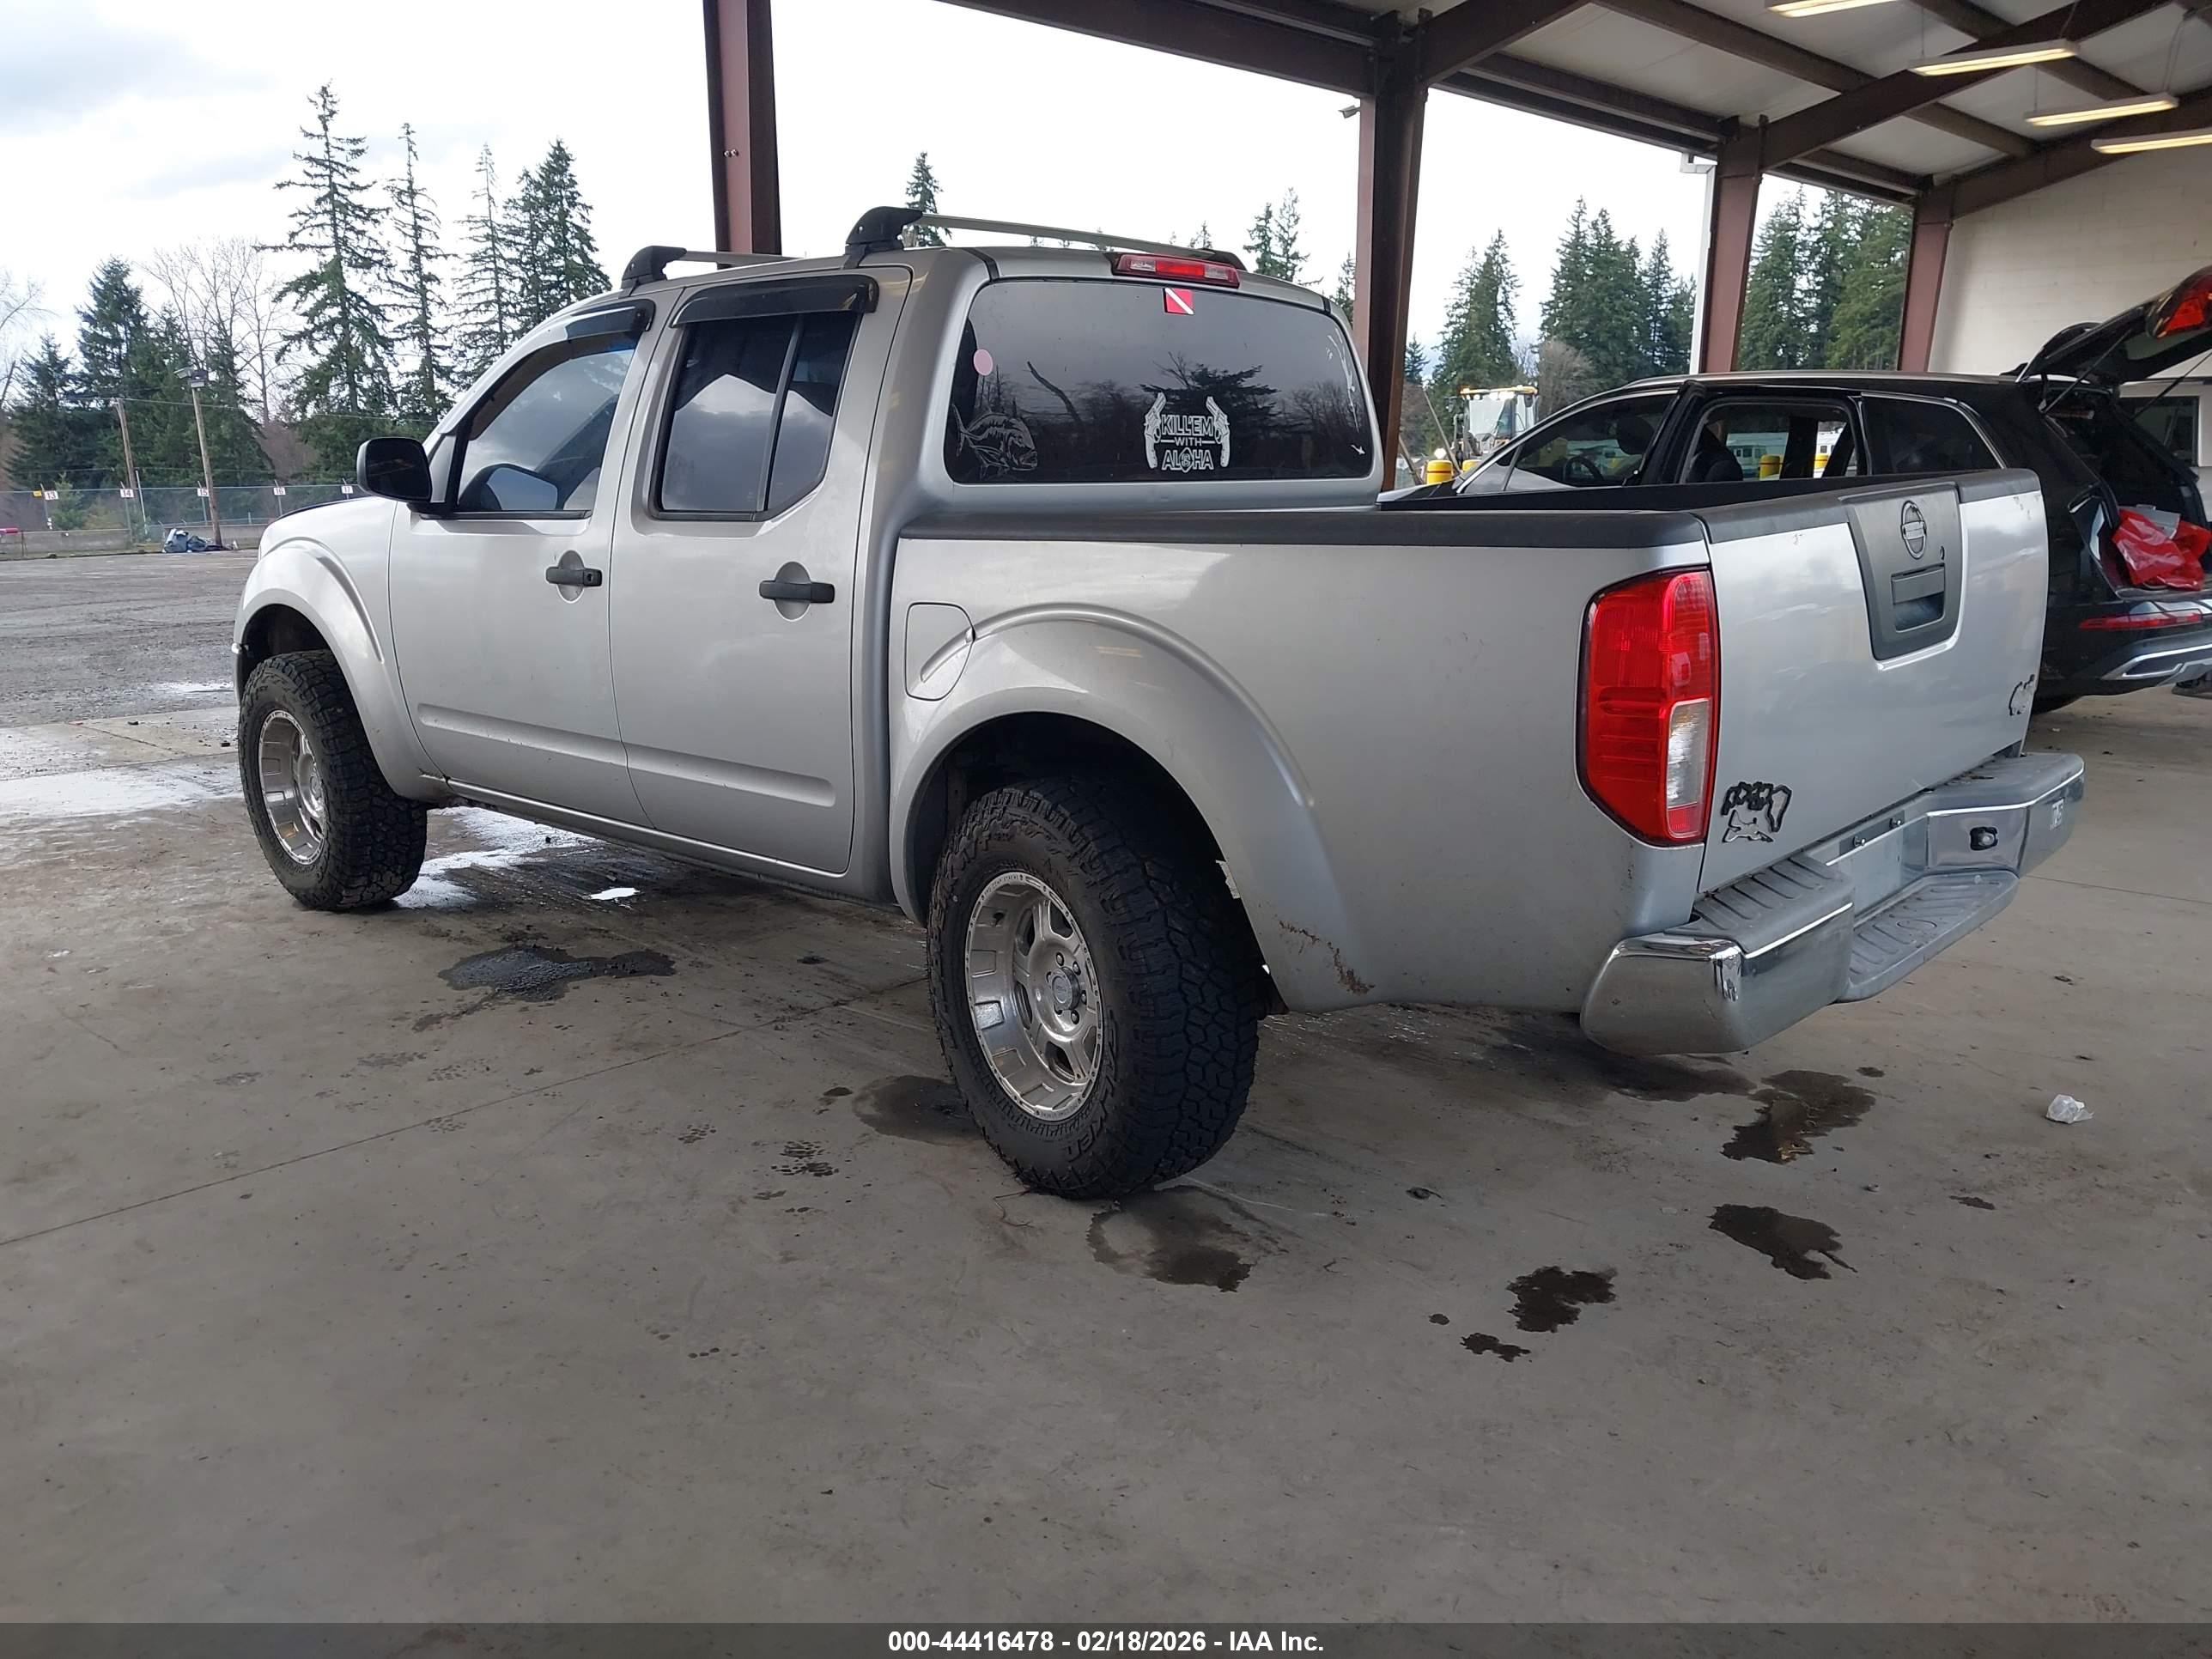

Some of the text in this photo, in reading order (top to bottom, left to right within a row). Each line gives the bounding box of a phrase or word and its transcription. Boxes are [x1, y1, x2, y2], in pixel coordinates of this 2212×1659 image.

[1175, 437, 1202, 447] WITH
[1162, 447, 1214, 472] ALOHA
[46, 490, 56, 500] 13
[123, 489, 131, 497] 14
